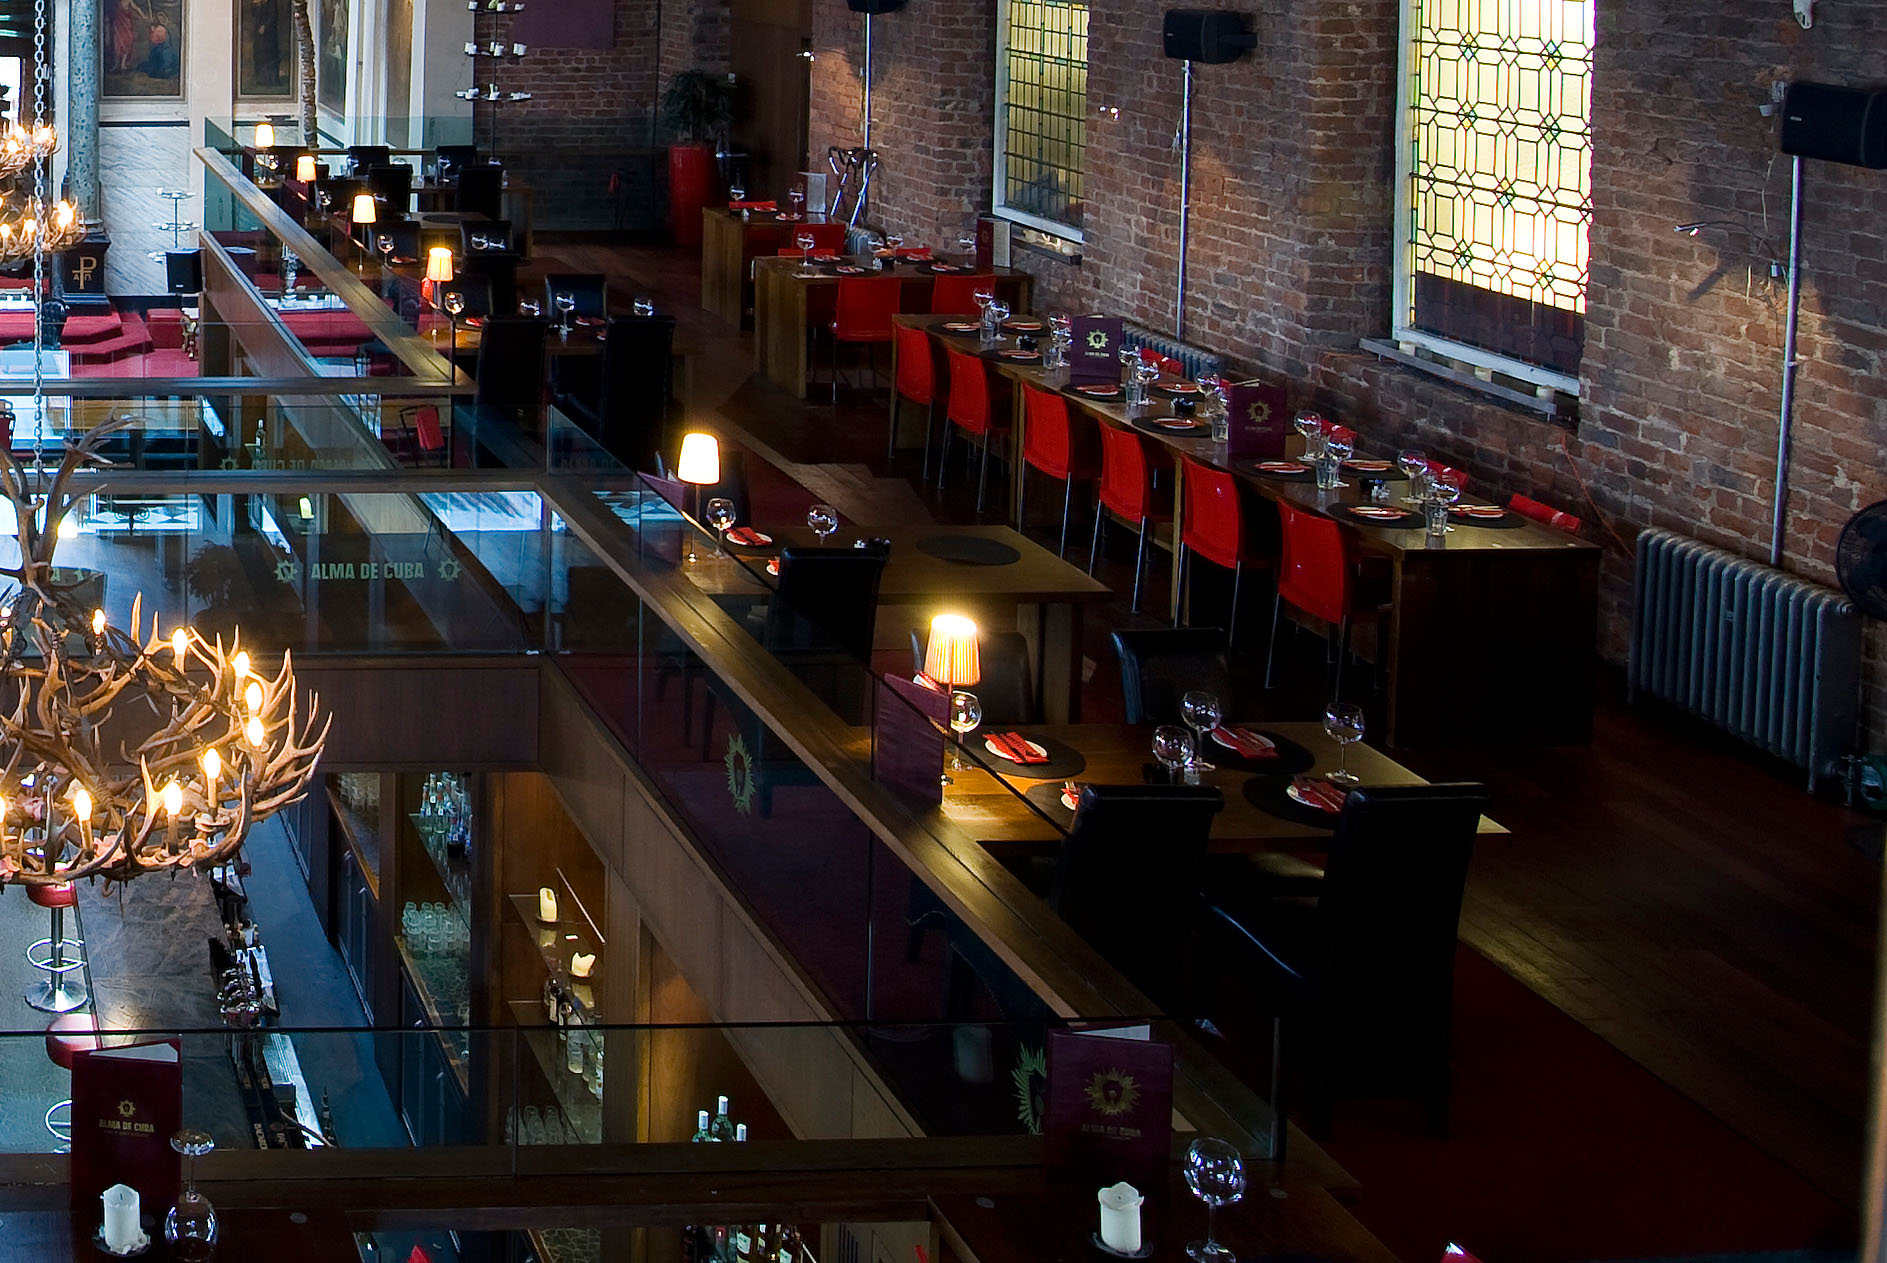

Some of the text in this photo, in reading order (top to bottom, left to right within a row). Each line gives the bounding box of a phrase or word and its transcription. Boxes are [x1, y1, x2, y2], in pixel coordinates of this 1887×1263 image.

[311, 562, 425, 580] ALMA DE CUBA
